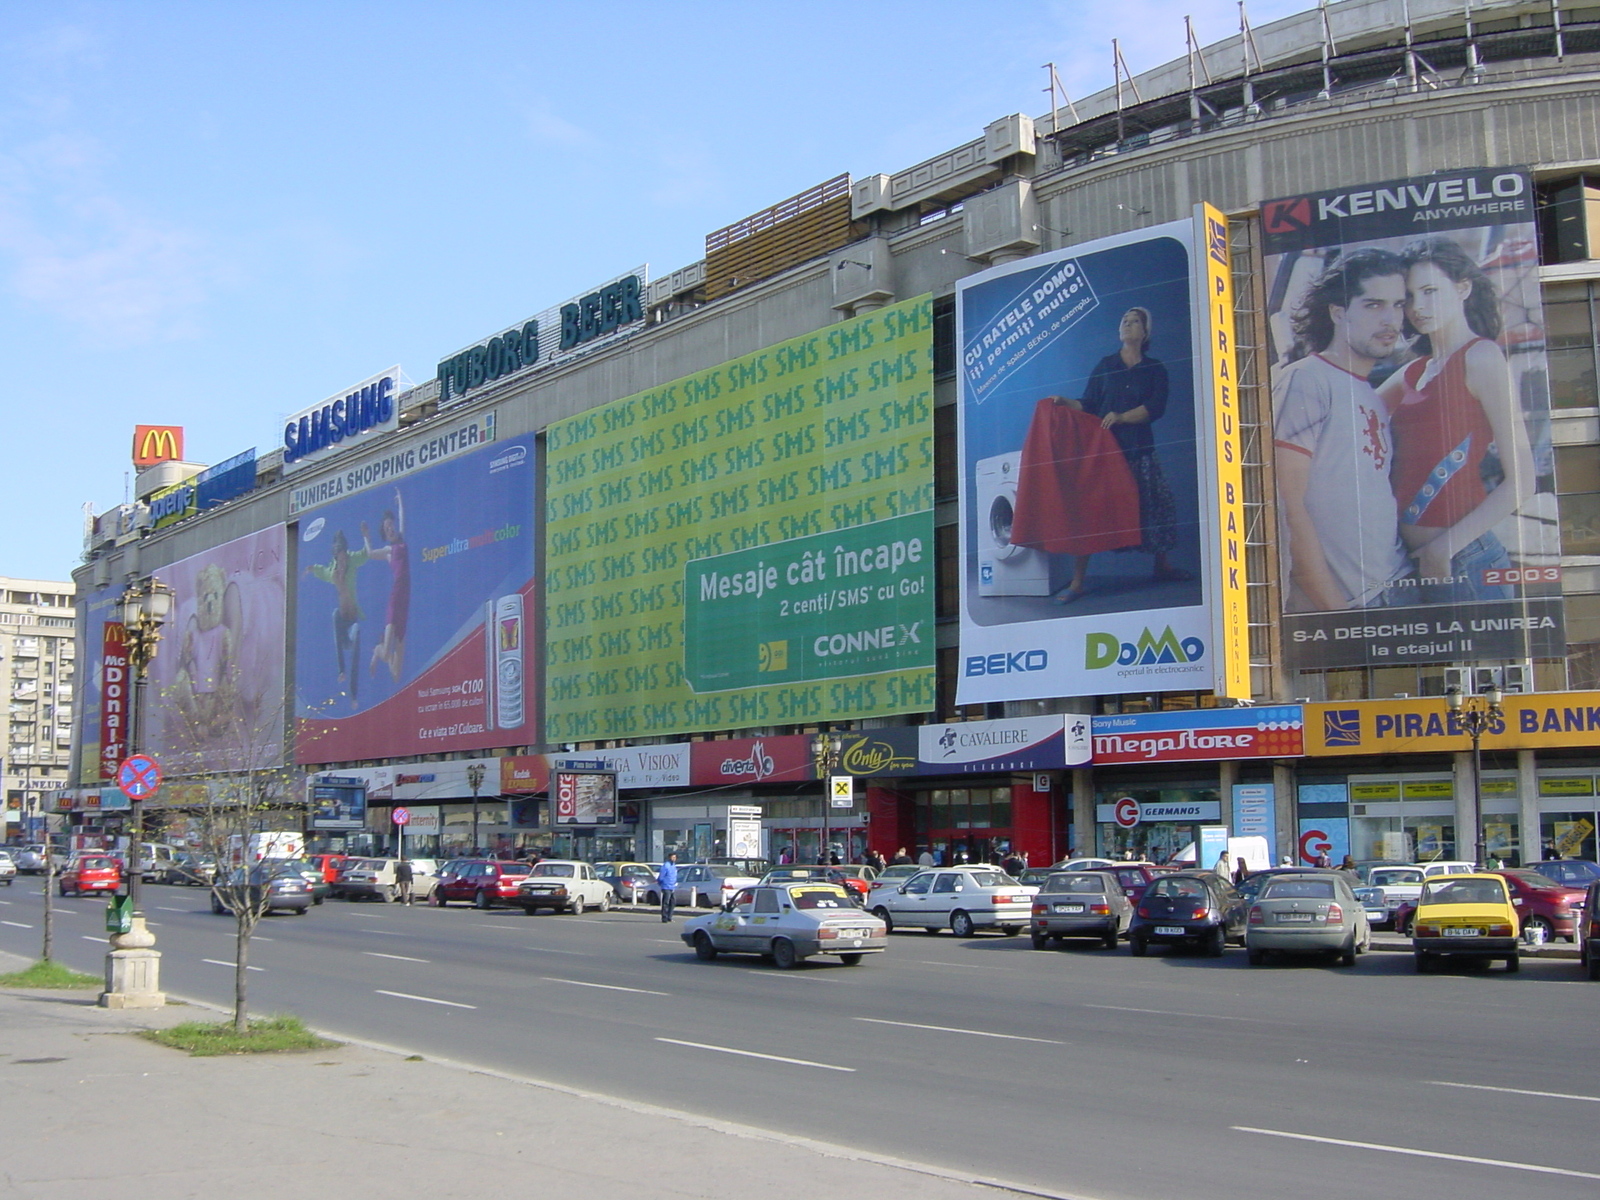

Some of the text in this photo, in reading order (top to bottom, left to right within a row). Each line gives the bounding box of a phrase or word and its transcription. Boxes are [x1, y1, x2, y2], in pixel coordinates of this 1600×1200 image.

[1318, 173, 1523, 220] KENVELO
[1412, 200, 1525, 222] ANYWHERE
[559, 274, 643, 350] BEER
[965, 344, 982, 366] CU
[982, 298, 1034, 349] RATELE
[1032, 263, 1075, 304] DOMO
[1038, 276, 1084, 319] multe!
[437, 319, 539, 401] TUBORG
[997, 365, 1006, 374] de
[1027, 330, 1051, 350] BEKO,
[1051, 321, 1060, 331] de
[566, 413, 596, 445] SMS
[602, 400, 635, 433] SMS
[641, 386, 676, 420] SMS
[683, 371, 720, 406] SMS
[728, 355, 768, 392] SMS
[775, 337, 818, 376] SMS
[827, 319, 873, 359] SMS
[1215, 276, 1233, 464] PIRAEUS
[284, 376, 394, 463] SAMSUNG
[556, 453, 585, 484] SMS
[592, 441, 623, 472] SMS
[630, 428, 664, 461] SMS
[671, 415, 708, 449] SMS
[715, 400, 754, 436] SMS
[762, 384, 804, 421] SMS
[813, 368, 858, 407] SMS
[868, 349, 916, 391] SMS
[300, 423, 478, 508] UNIREA SHOPPING CENTER
[562, 487, 592, 517] SMS
[598, 476, 631, 507] SMS
[638, 465, 673, 497] SMS
[680, 452, 717, 486] SMS
[725, 438, 764, 474] SMS
[772, 424, 815, 461] SMS
[824, 408, 869, 447] SMS
[879, 391, 928, 432] SMS
[551, 527, 580, 556] SMS
[586, 517, 618, 547] SMS
[624, 507, 659, 538] SMS
[665, 496, 702, 528] SMS
[709, 484, 748, 519] SMS
[757, 471, 798, 507] SMS
[807, 458, 851, 495] SMS
[861, 442, 909, 482] SMS
[1225, 482, 1239, 590] BANK
[565, 559, 595, 589] SMS
[601, 551, 635, 581] SMS
[642, 541, 677, 573] SMS
[700, 561, 778, 602] Mesaje
[787, 550, 826, 585] cât
[833, 537, 922, 578] încape
[1367, 568, 1559, 589] summer 2003
[556, 599, 585, 627] SMS
[591, 591, 623, 620] SMS
[629, 583, 664, 614] SMS
[780, 600, 789, 617] 2
[877, 584, 894, 600] cu
[900, 576, 925, 596] Go!
[563, 635, 592, 662] SMS
[598, 628, 631, 657] SMS
[637, 621, 672, 651] SMS
[814, 622, 920, 657] CONNEX
[1233, 602, 1241, 684] ROMANIA
[1293, 616, 1556, 642] S-A DESCHIS LA UNIREA
[1372, 644, 1389, 656] la
[1396, 640, 1453, 656] etajul
[551, 663, 658, 701] SMS SMS SMS
[965, 649, 1048, 677] BEKO
[566, 709, 597, 736] SMS
[603, 705, 636, 733] SMS
[643, 701, 676, 729] SMS
[683, 697, 720, 726] SMS
[729, 691, 768, 722] SMS
[777, 686, 820, 718] SMS
[830, 680, 876, 713] SMS
[1092, 718, 1136, 728] Sony Music
[1376, 705, 1600, 738] PIRAES BANK
[851, 748, 882, 769] Only
[960, 728, 1028, 747] CAVALIERE
[513, 769, 530, 779] Kodak
[638, 751, 680, 771] VISION
[721, 758, 755, 775] diverta
[508, 778, 537, 789] EXPRESS
[1145, 806, 1201, 816] GERMANOS
